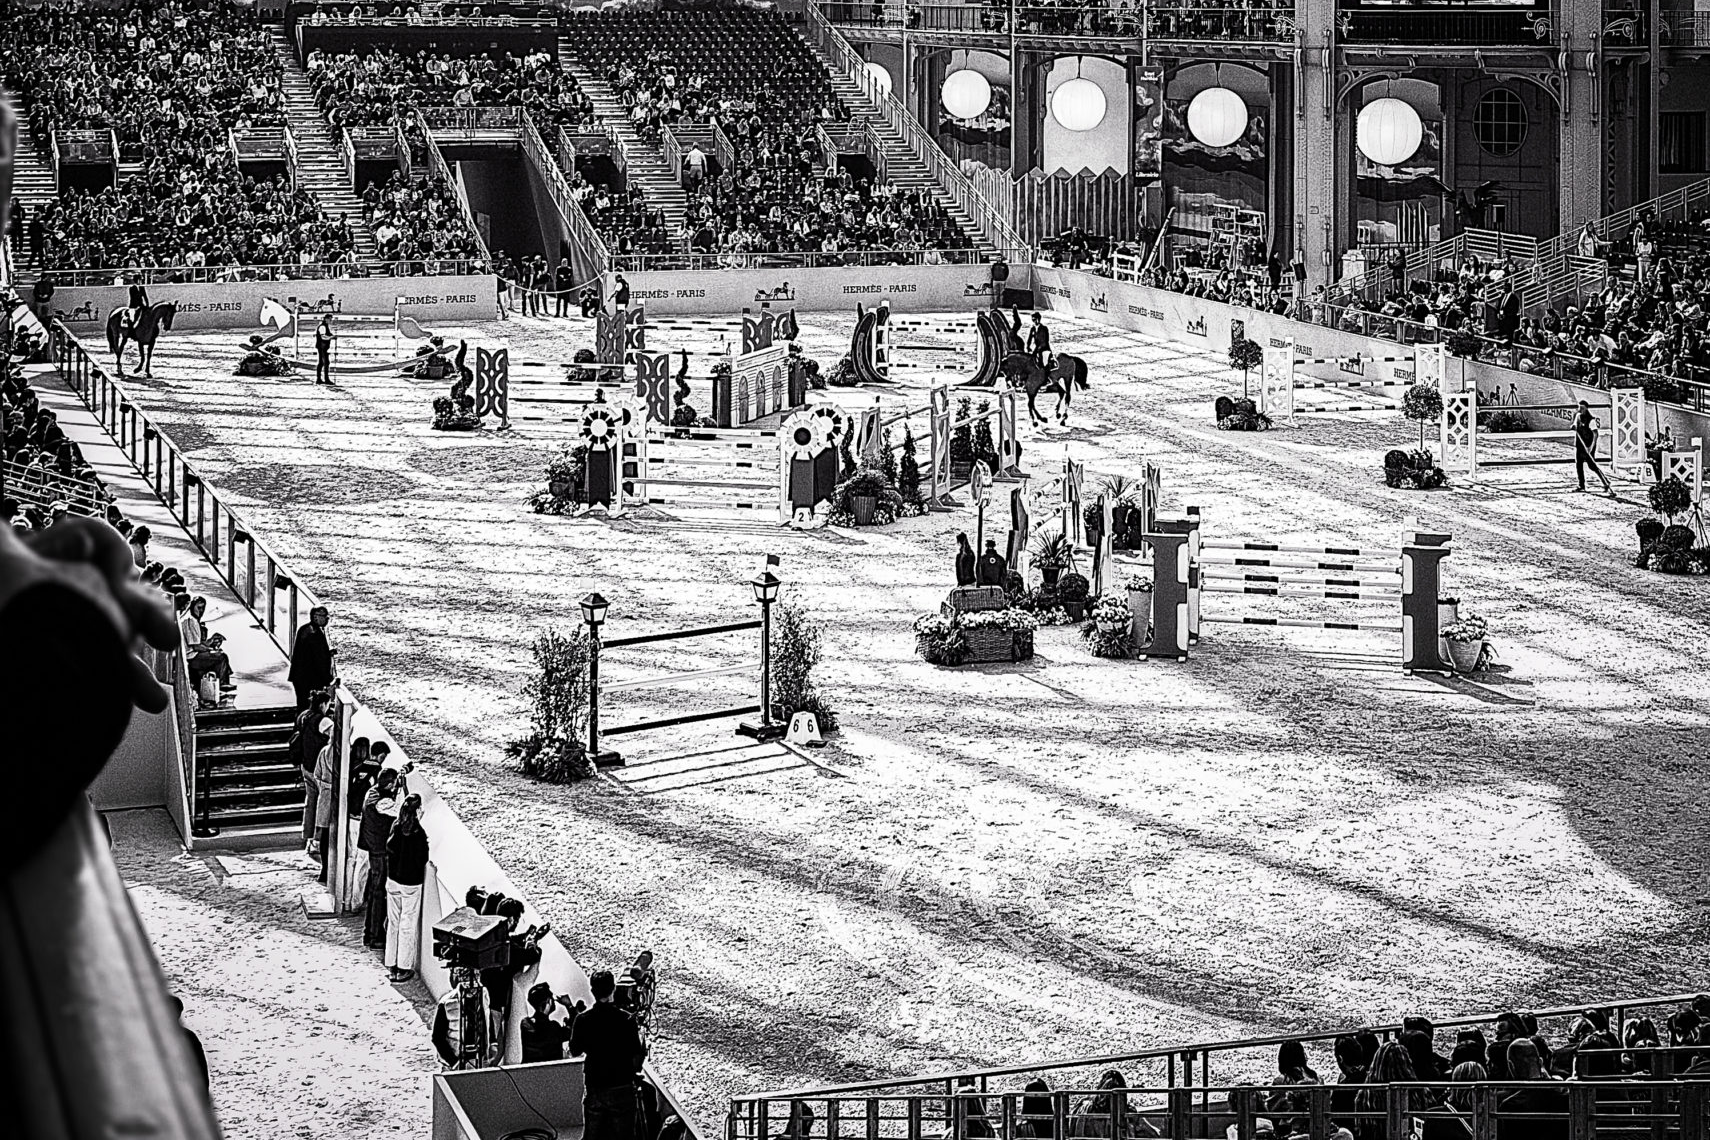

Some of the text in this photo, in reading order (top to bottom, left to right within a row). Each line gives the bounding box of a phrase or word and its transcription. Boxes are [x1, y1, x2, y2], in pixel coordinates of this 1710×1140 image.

[629, 288, 669, 299] HERMÈS
[676, 289, 706, 298] PARIS
[843, 284, 881, 294] HERMÈS
[889, 284, 917, 293] PARIS
[397, 295, 438, 305] ERMÈS
[445, 294, 476, 304] PARIS
[177, 302, 201, 313] MÈS
[208, 302, 242, 312] PARIS
[1295, 344, 1313, 357] PARIS
[798, 512, 805, 522] 2
[793, 718, 800, 733] 6
[807, 718, 814, 733] 6
